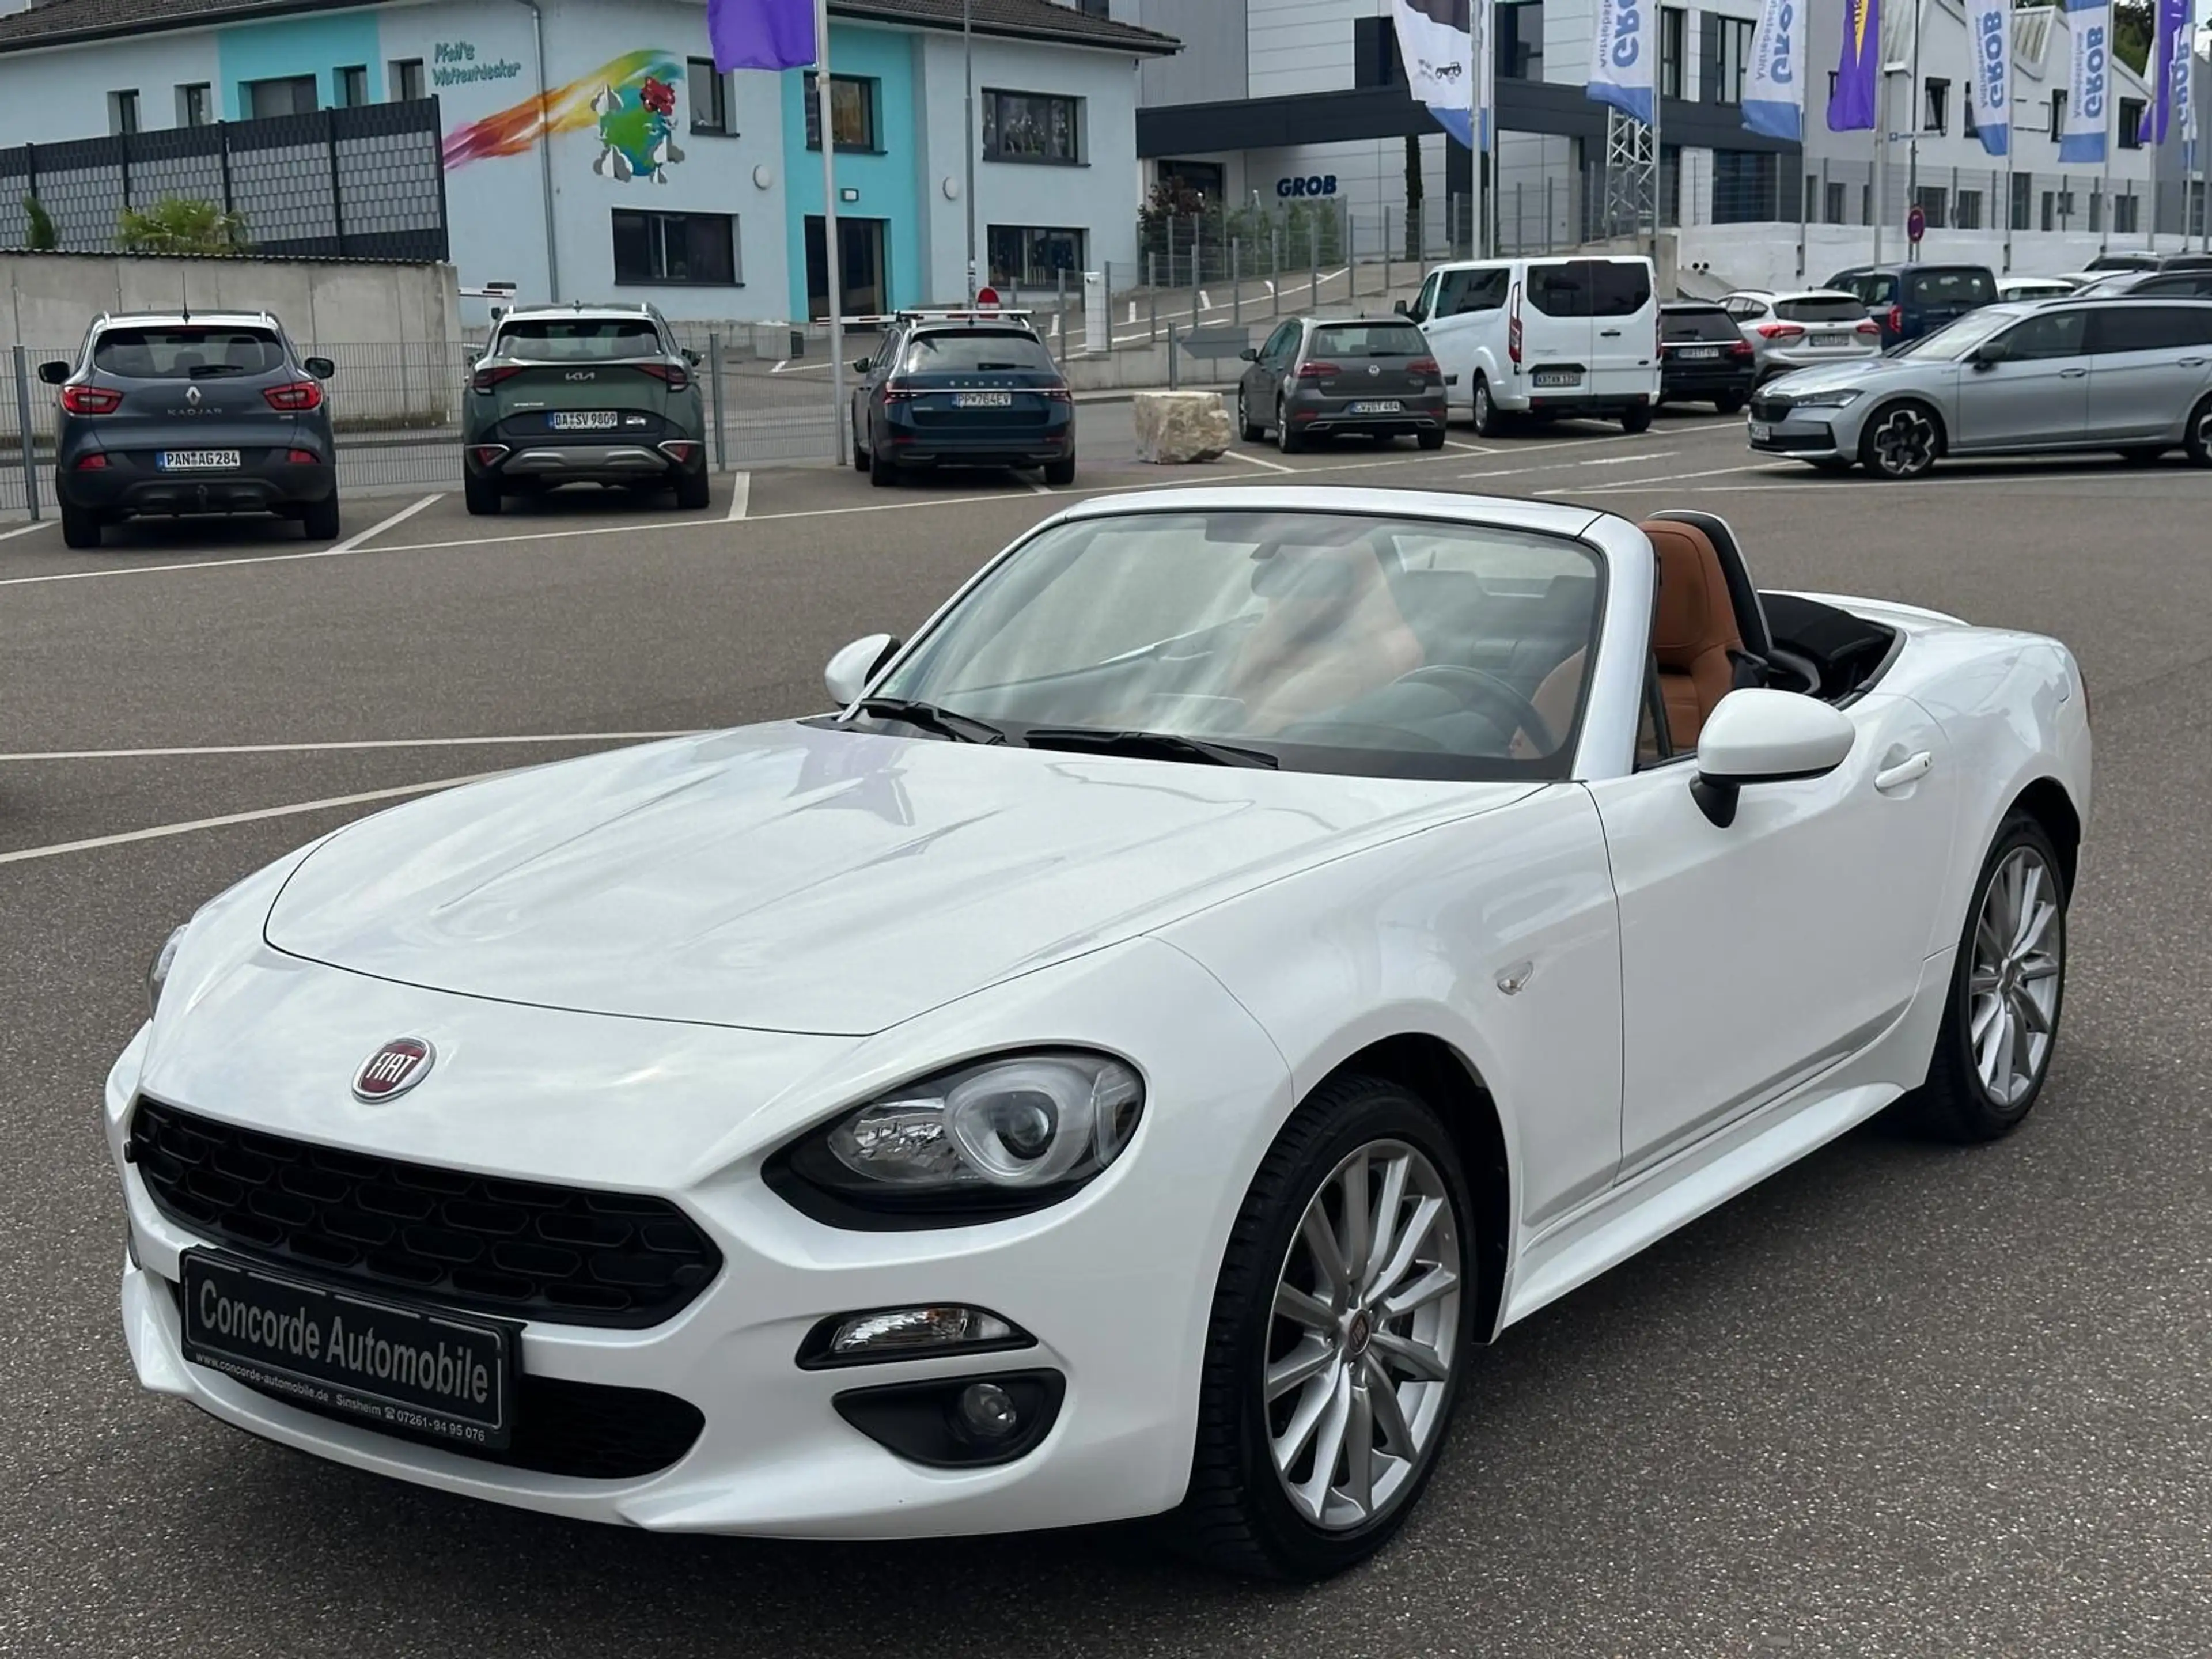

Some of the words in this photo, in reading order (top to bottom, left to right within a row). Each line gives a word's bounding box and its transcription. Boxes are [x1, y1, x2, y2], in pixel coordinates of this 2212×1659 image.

[1277, 175, 1337, 197] GROB
[576, 414, 588, 425] SV
[166, 453, 190, 466] PAN
[199, 453, 214, 465] AG
[217, 452, 238, 465] 284
[365, 1052, 418, 1083] FIAT
[200, 1279, 320, 1361] Concorde
[325, 1316, 488, 1404] Automobile
[195, 1352, 329, 1402] www.concorde-automobile.de
[336, 1394, 381, 1416] Sinsheim
[449, 1422, 463, 1437] 95
[465, 1426, 486, 1442] 076
